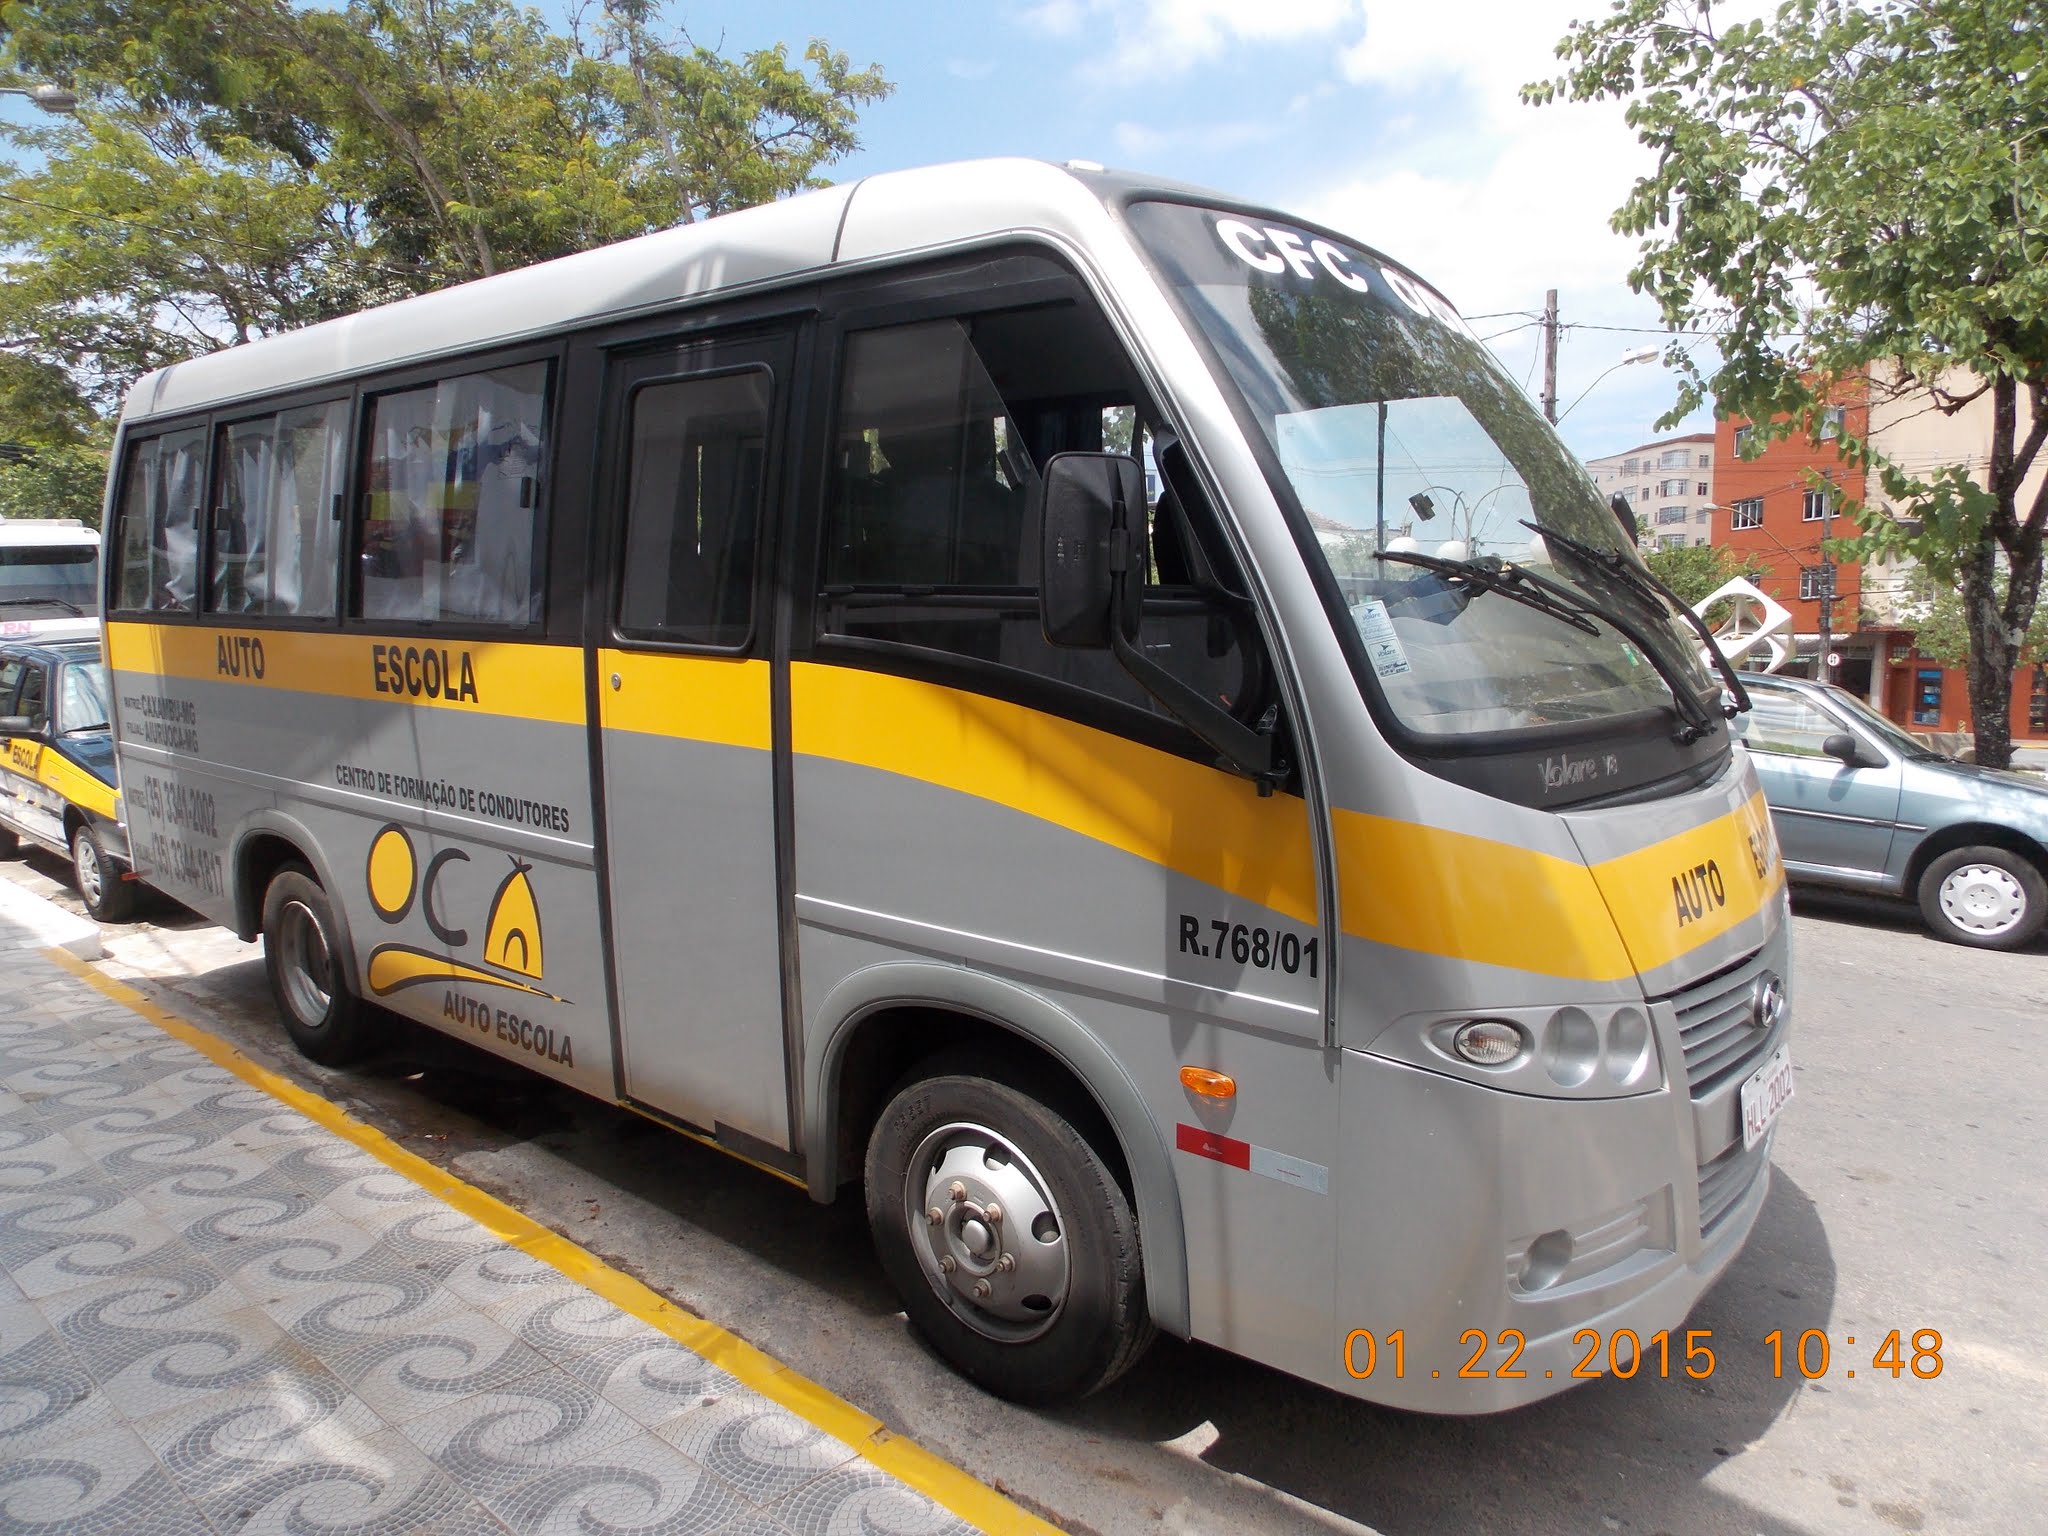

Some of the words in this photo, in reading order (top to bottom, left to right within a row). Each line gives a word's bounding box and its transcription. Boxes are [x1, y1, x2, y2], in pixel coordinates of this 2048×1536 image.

[1216, 219, 1368, 292] CFC
[217, 635, 264, 679] AUTO
[372, 644, 479, 704] ESCOLA
[13, 745, 39, 772] ESCOLA
[336, 764, 375, 791] CENTRO
[378, 772, 392, 795] DE
[394, 775, 456, 809] FORMAÇÃO
[460, 787, 476, 812] DE
[478, 792, 570, 833] CONDUTORES
[1671, 859, 1725, 928] AUTO
[1179, 914, 1318, 979] R.768/01
[444, 991, 491, 1033] AUTO
[496, 1008, 574, 1068] ESCOLA
[1768, 1063, 1792, 1116] 2002
